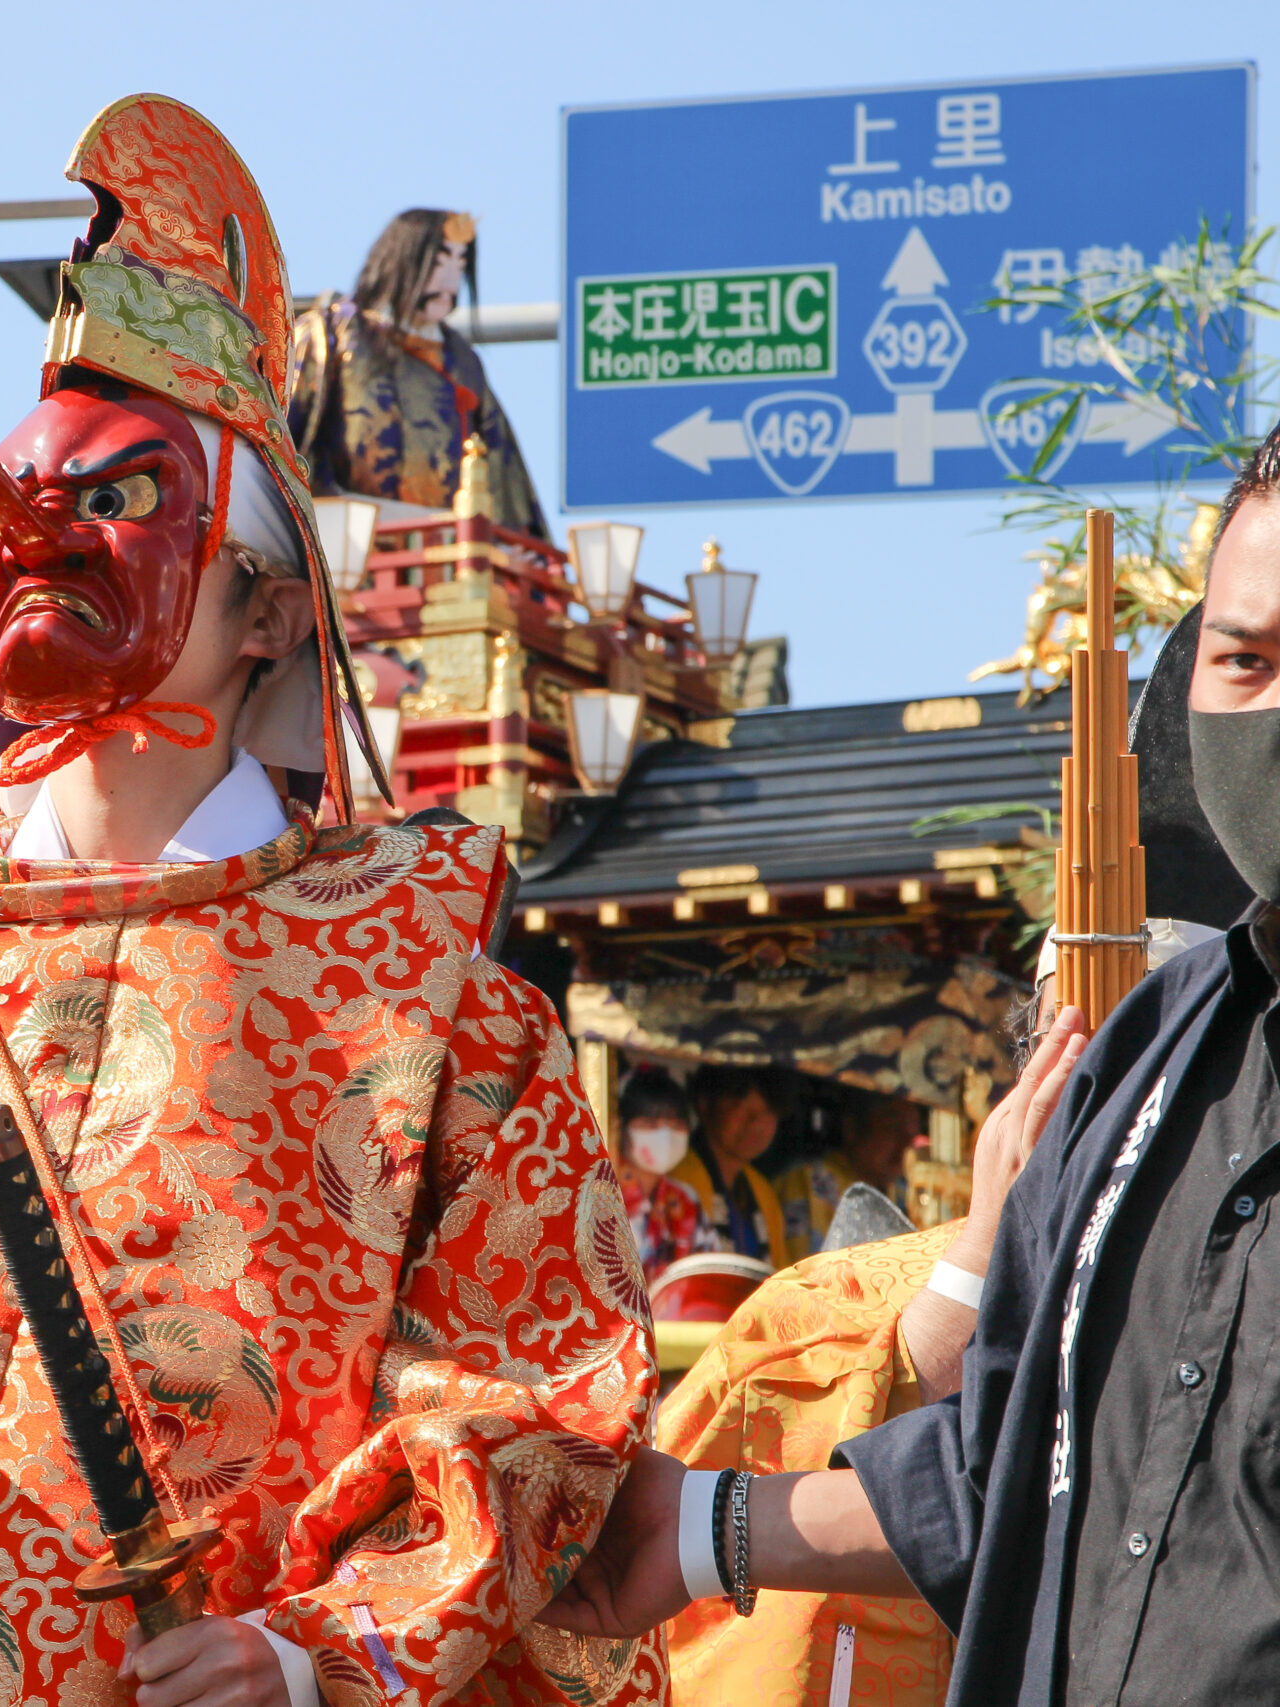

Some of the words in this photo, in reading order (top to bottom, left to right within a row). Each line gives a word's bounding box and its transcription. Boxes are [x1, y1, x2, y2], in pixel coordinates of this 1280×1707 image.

[827, 93, 1006, 176] 上里
[821, 174, 1012, 223] Kamisato
[586, 275, 825, 343] 本庄児玉IC
[589, 340, 823, 382] Honjo-Kodama
[874, 320, 950, 370] 392
[757, 411, 834, 458] 462
